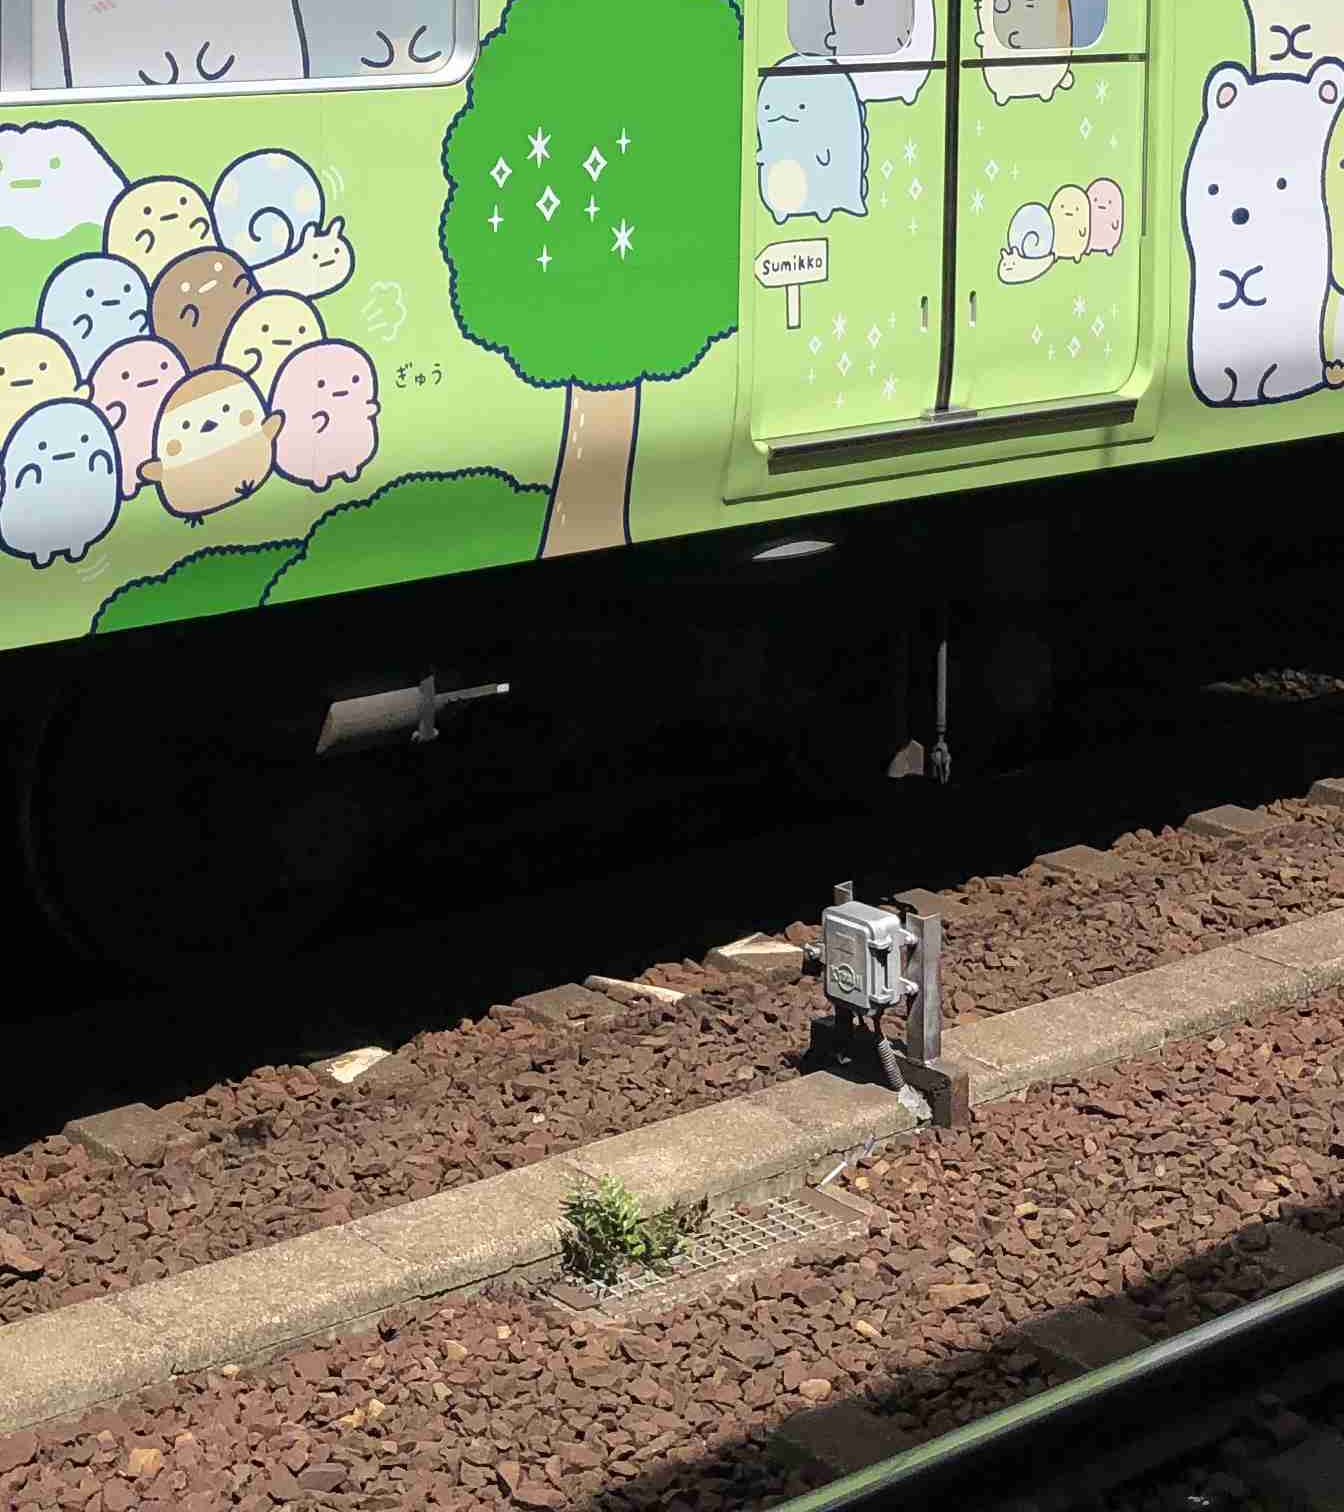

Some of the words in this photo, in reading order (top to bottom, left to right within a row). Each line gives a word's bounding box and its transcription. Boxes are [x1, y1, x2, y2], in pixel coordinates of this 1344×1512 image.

[762, 254, 823, 276] Sumikko
[395, 361, 442, 388] ぎゅう
